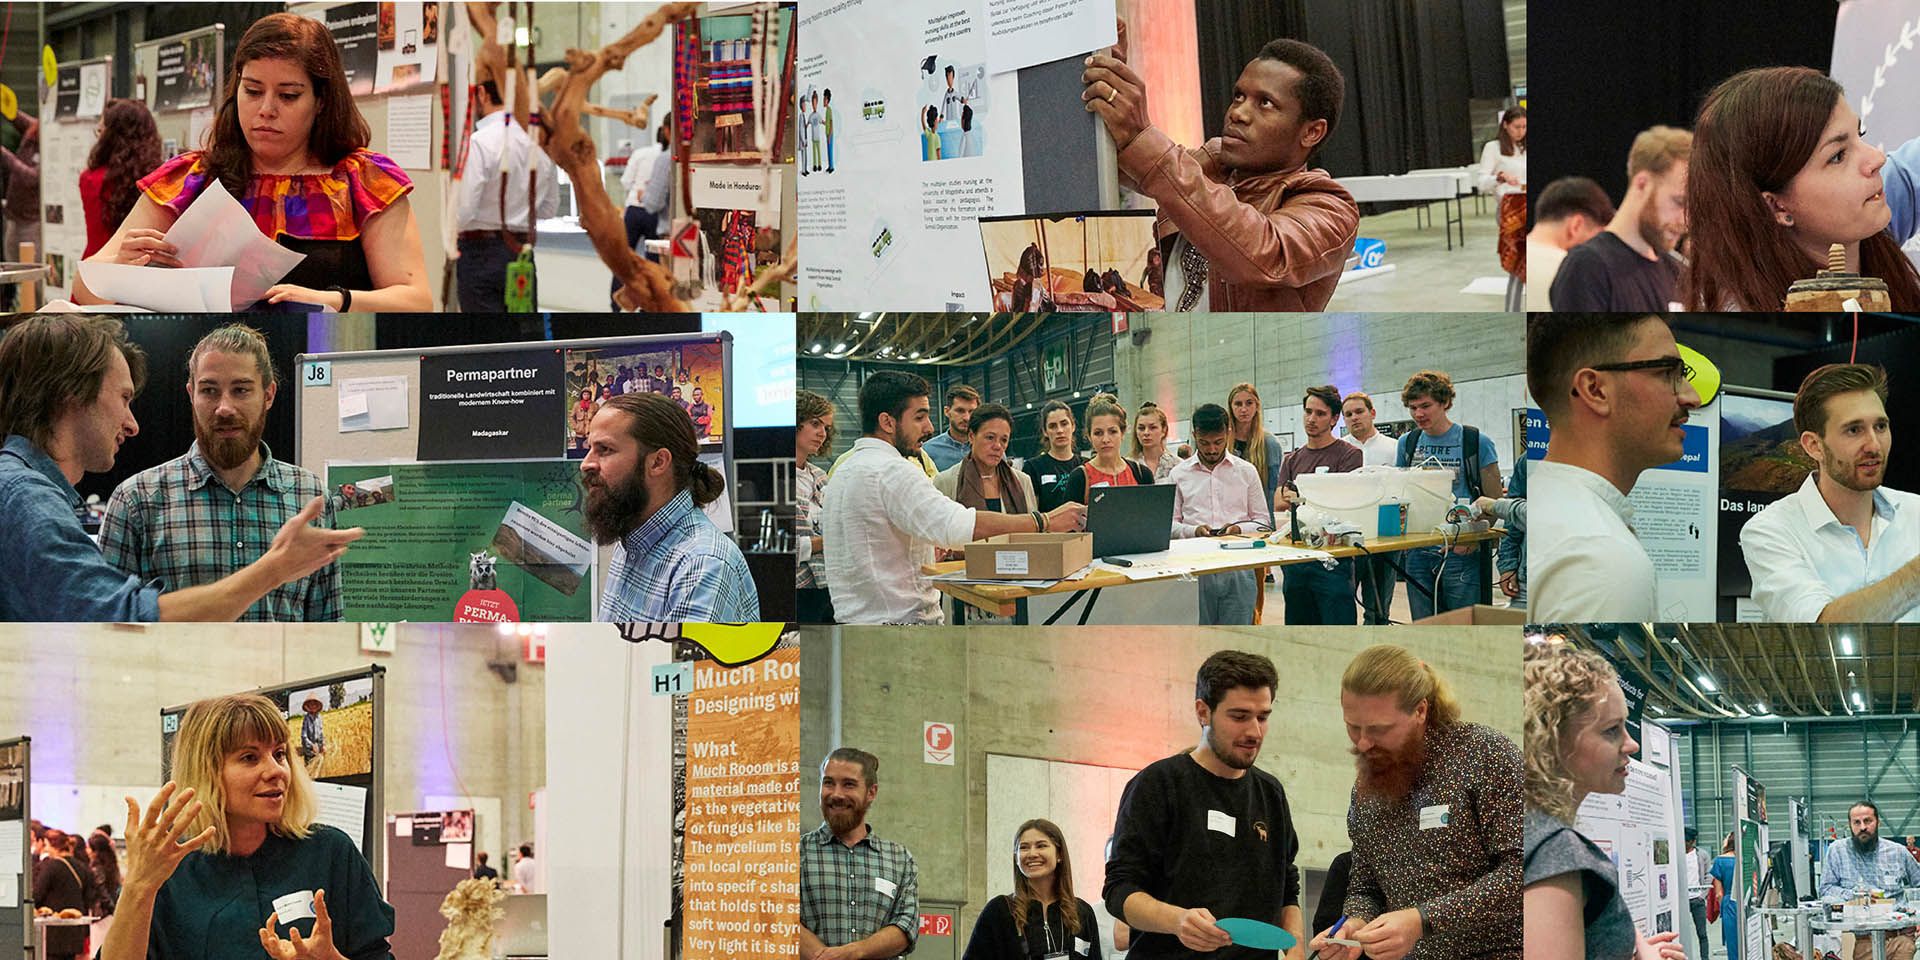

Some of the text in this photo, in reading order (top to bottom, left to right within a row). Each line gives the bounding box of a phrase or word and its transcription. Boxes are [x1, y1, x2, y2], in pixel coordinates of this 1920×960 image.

[709, 180, 726, 189] Made
[727, 181, 733, 189] in
[307, 365, 325, 381] J8
[446, 367, 538, 383] Permapartner
[429, 392, 465, 400] traditionelle
[465, 389, 511, 399] Landwirtschaft
[511, 389, 544, 397] kombiniert
[458, 398, 525, 407] modernem Know-how
[472, 429, 509, 438] Madagaskar
[1681, 453, 1700, 462] epal
[1720, 498, 1744, 512] Das
[480, 599, 500, 609] JETZT
[655, 673, 681, 693] H1
[695, 665, 755, 691] Much
[695, 691, 776, 716] Designing
[931, 727, 947, 747] F
[692, 740, 738, 759] What
[692, 760, 800, 777] Much Rooom is a
[692, 778, 800, 797] material made of
[691, 802, 702, 816] is
[706, 802, 727, 815] the
[691, 823, 704, 834] or
[707, 820, 754, 837] fungus
[757, 820, 783, 833] like
[690, 839, 792, 857] The mycelium is
[690, 859, 797, 876] on local organic
[689, 879, 714, 892] into
[689, 898, 716, 911] that
[720, 899, 757, 913] holds
[760, 900, 784, 914] the
[689, 917, 714, 931] soft
[716, 919, 750, 932] wood
[753, 922, 767, 933] or
[689, 936, 716, 953] Very
[718, 938, 748, 955] light
[751, 939, 762, 953] it
[764, 939, 776, 954] is
